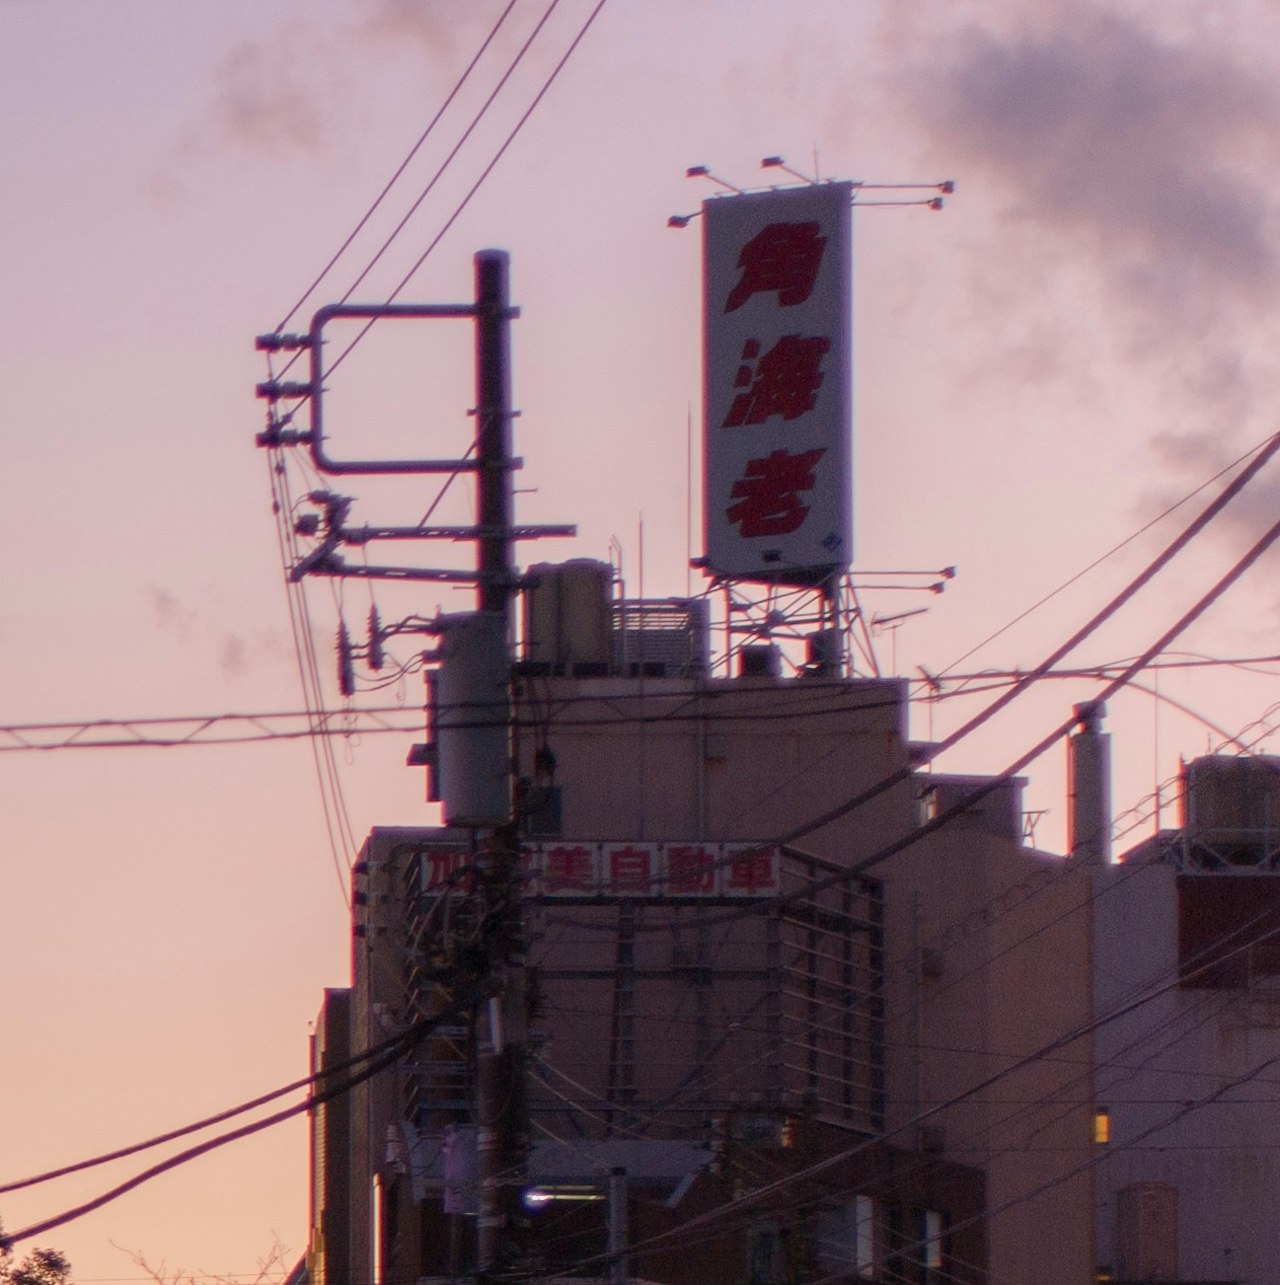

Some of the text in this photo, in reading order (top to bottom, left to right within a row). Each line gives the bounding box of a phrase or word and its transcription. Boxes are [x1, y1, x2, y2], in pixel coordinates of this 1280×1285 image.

[427, 845, 776, 893] 加美自動車
